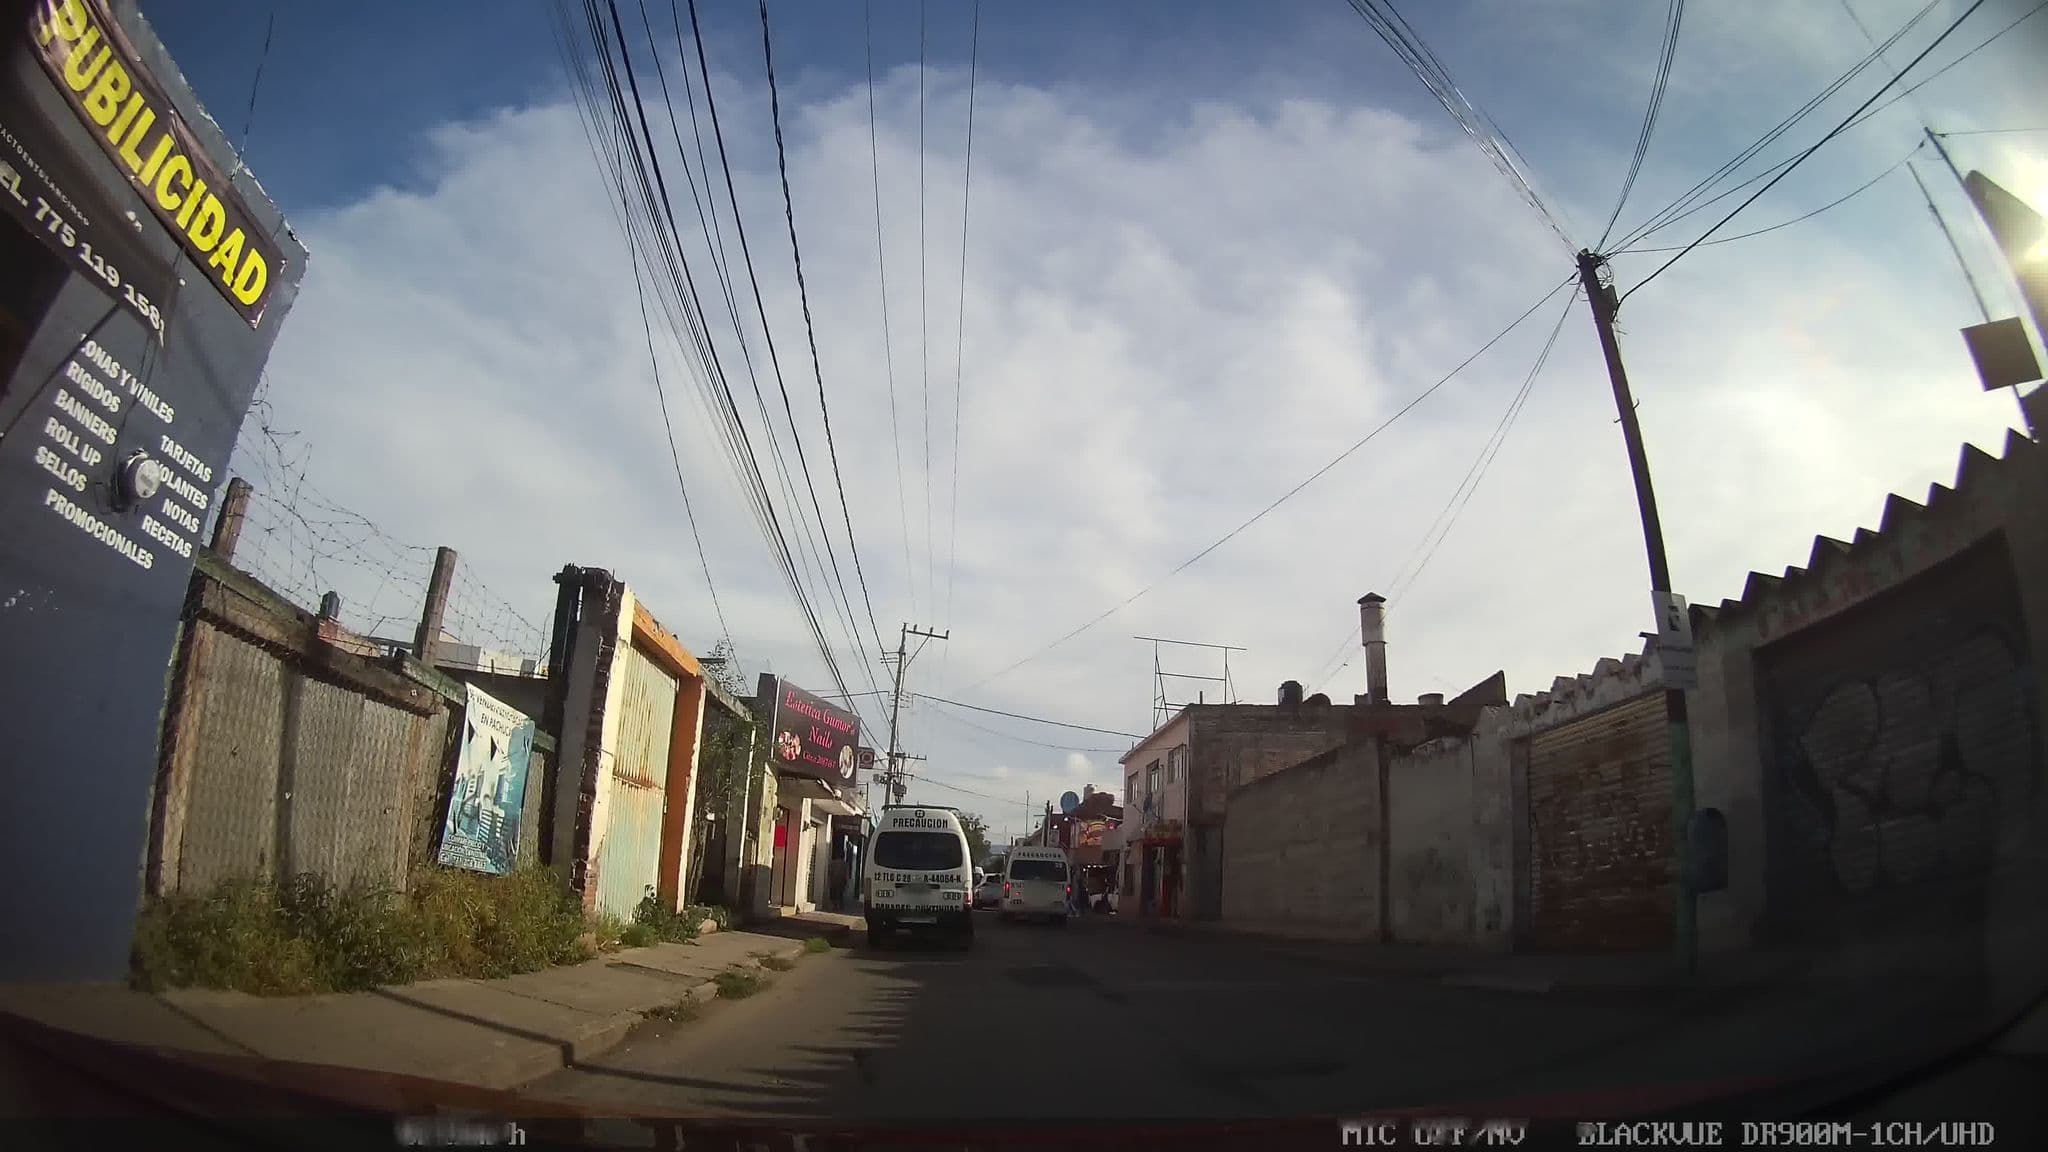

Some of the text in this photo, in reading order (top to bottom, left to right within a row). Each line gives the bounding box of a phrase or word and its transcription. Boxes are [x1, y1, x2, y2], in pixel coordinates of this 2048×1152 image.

[40, 0, 268, 306] PUBILICIDAD
[35, 196, 76, 247] 775
[79, 242, 120, 288] 119
[66, 360, 121, 413] RIGIDOS
[120, 369, 132, 387] Y
[129, 378, 175, 424] VINILES
[44, 416, 102, 467] ROLL UP
[54, 388, 118, 445] BANNERS
[34, 446, 89, 492] SELLOS
[160, 434, 212, 482] TARJETAS
[44, 488, 154, 570] PROMOCIONALES
[141, 514, 193, 558] RECETAS
[162, 498, 200, 533] NOTAS
[808, 725, 834, 749] Nails
[892, 817, 948, 828] PRECAUCION
